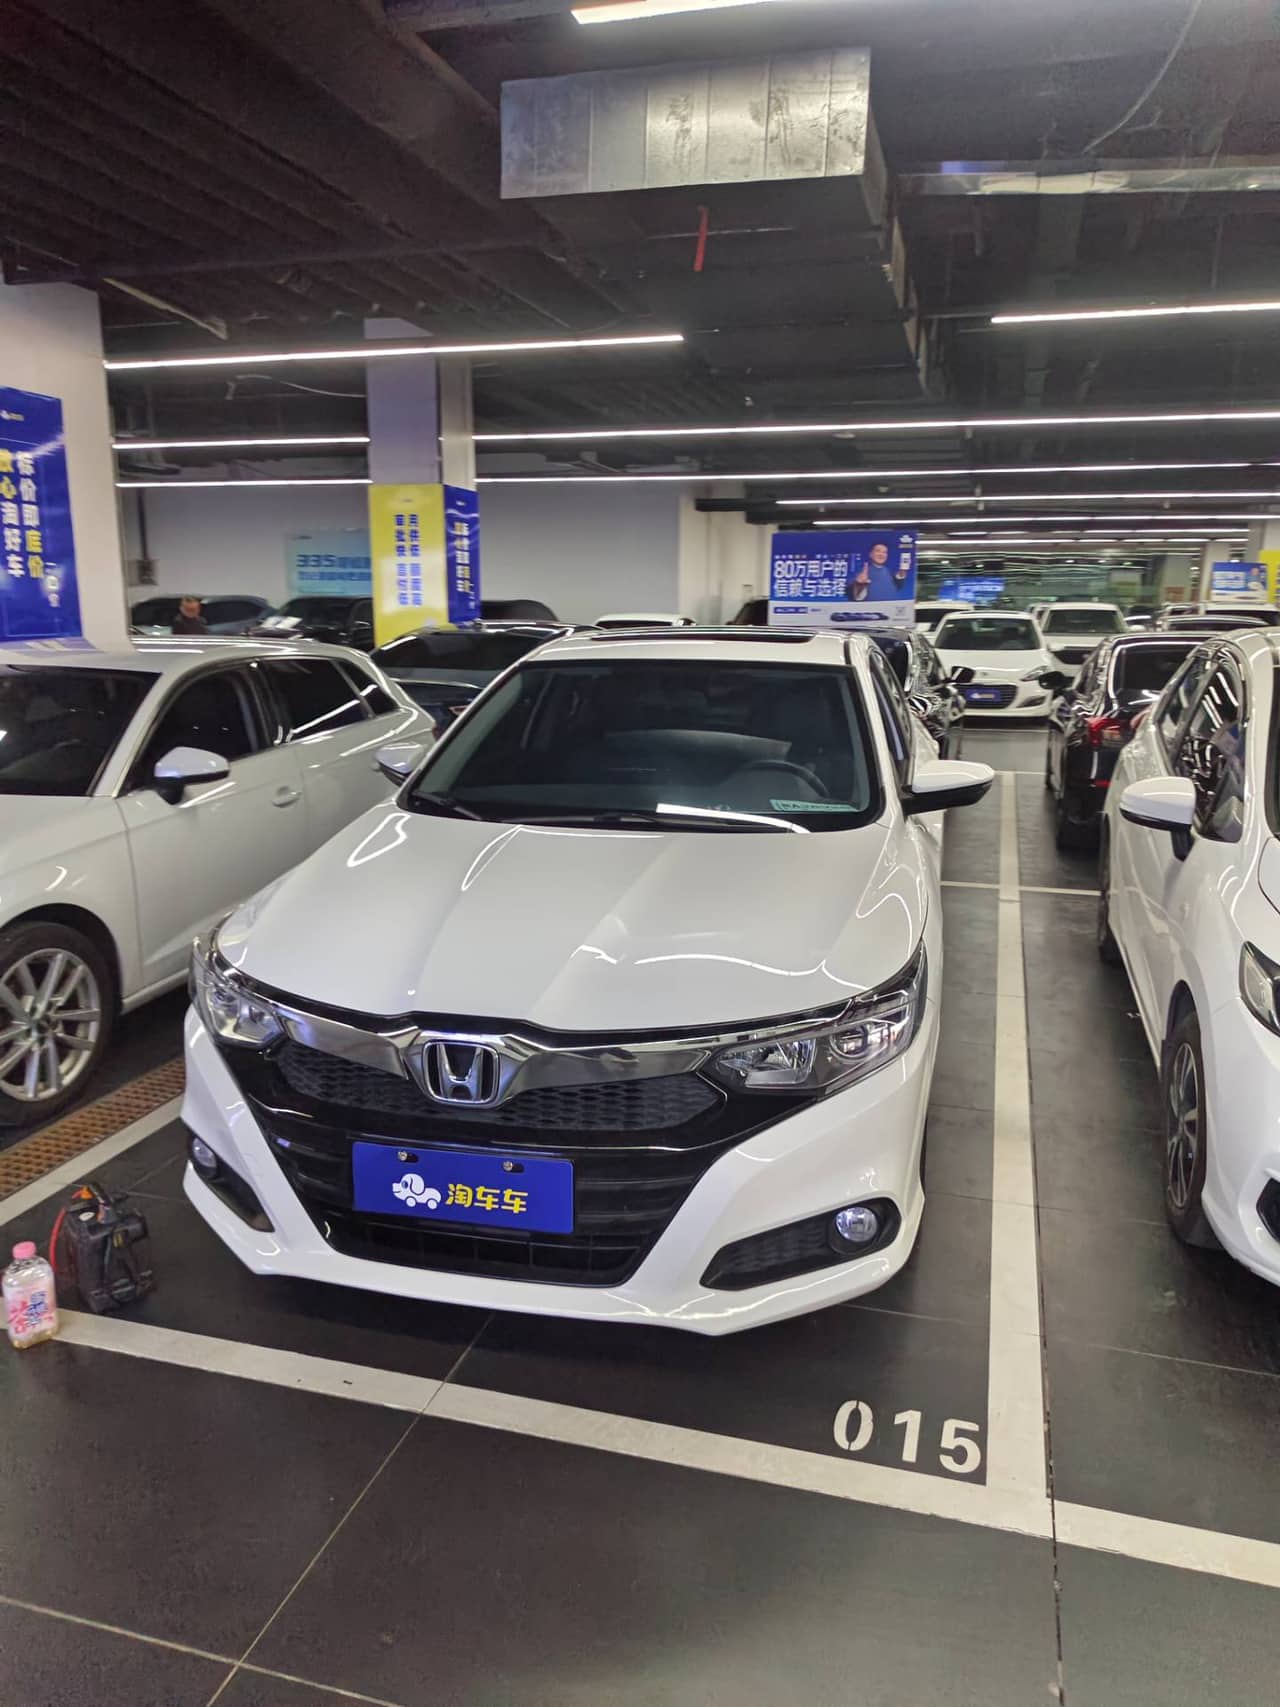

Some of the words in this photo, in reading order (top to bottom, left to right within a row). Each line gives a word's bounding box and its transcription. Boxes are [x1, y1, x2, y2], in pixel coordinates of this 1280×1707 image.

[774, 560, 848, 579] 80万用户的
[773, 578, 847, 598] 信赖与选择
[445, 1183, 529, 1214] 淘车车
[833, 1400, 981, 1474] 015
